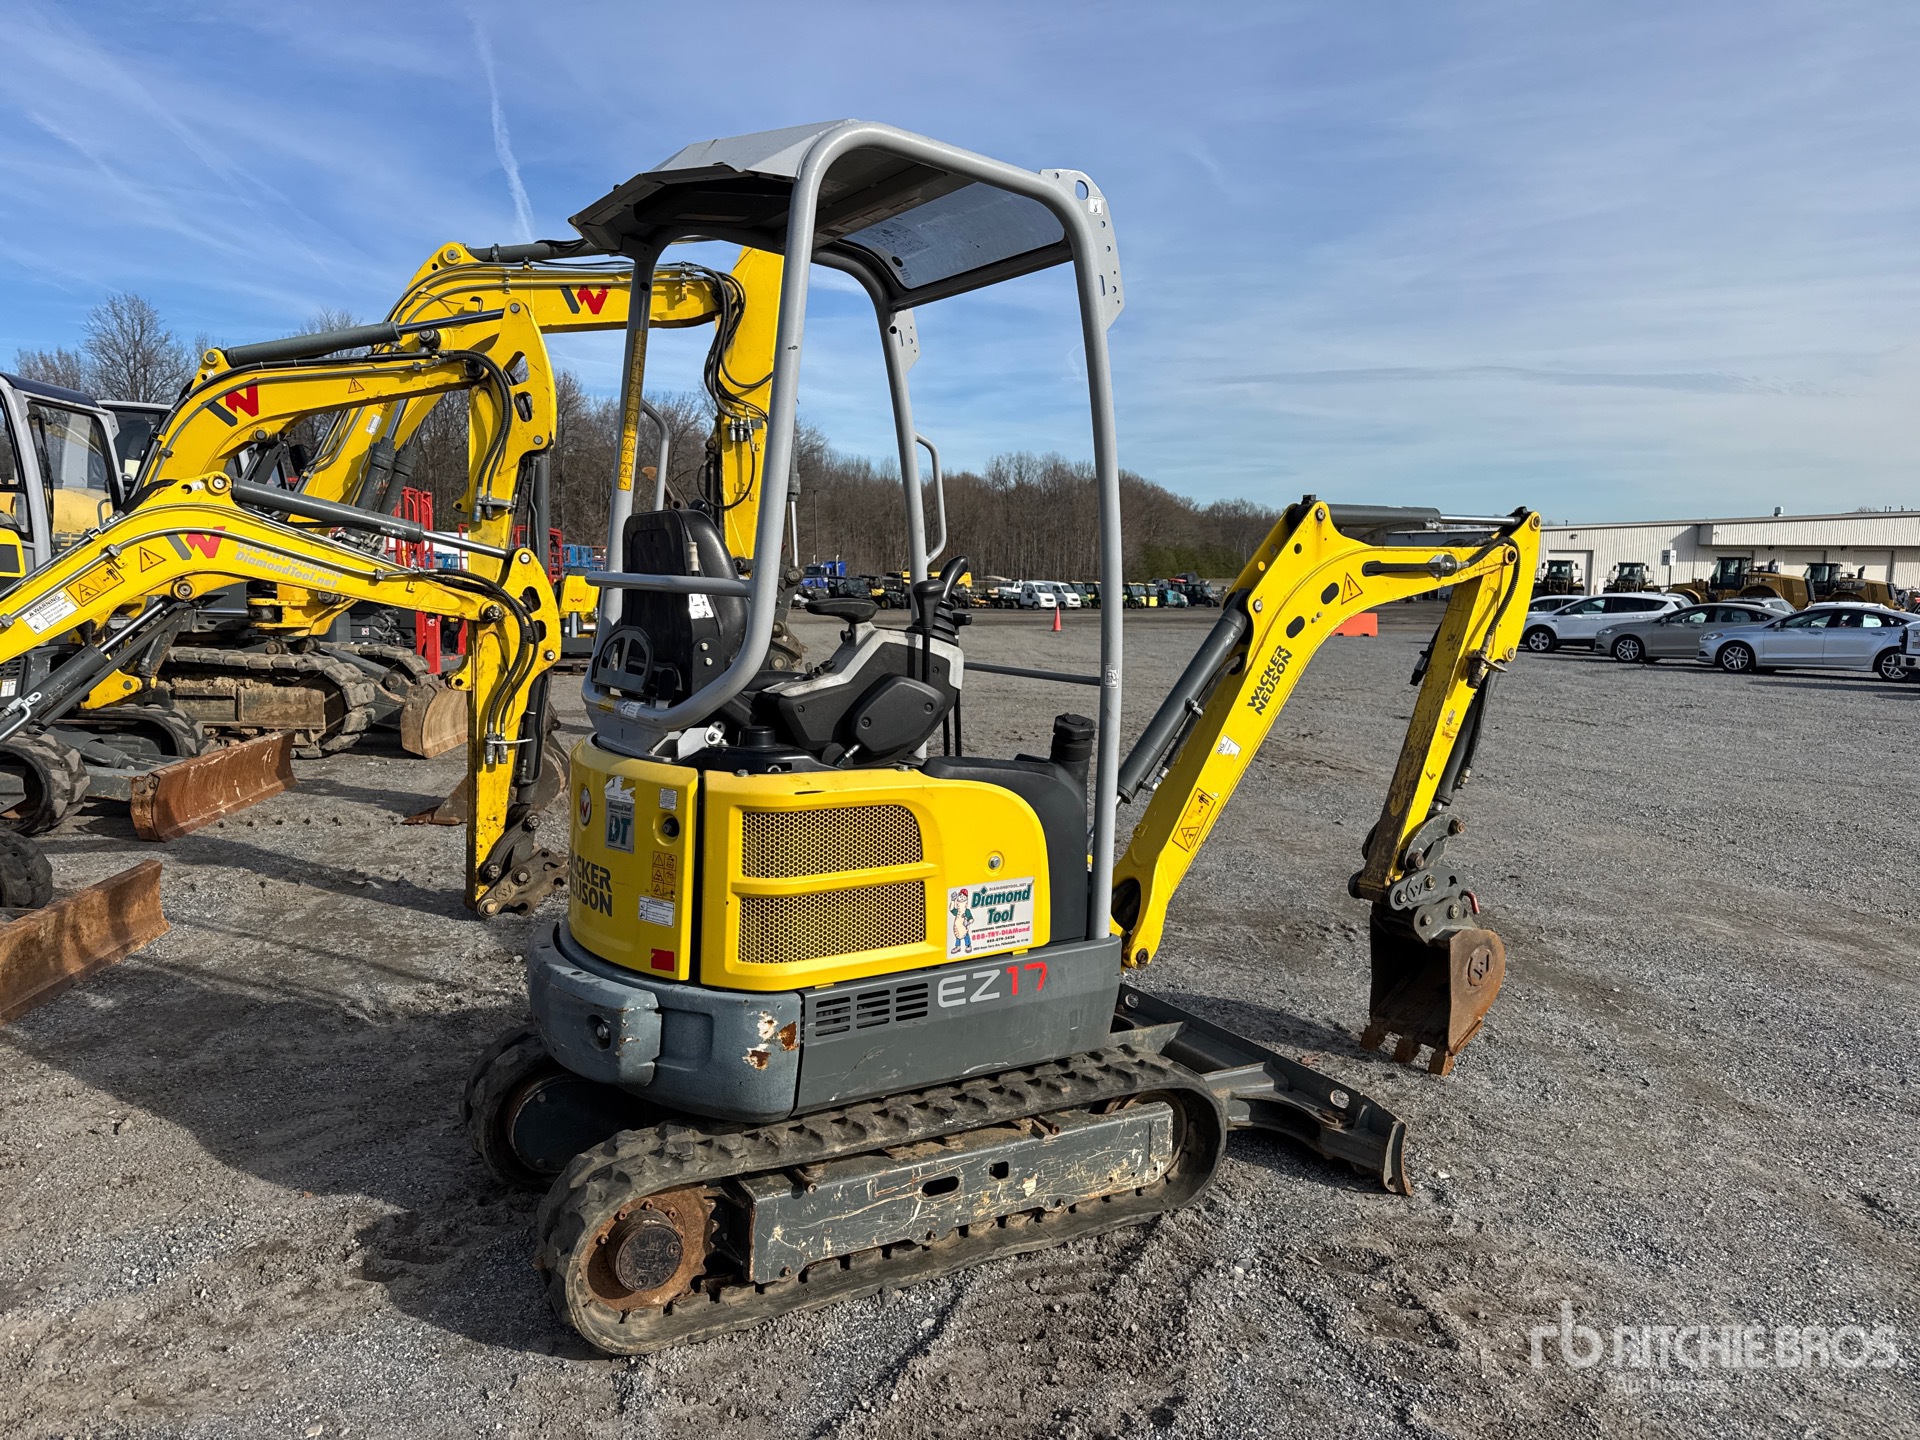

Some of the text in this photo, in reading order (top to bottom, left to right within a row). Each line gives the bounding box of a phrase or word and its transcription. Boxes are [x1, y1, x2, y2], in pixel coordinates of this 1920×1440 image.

[235, 551, 337, 588] DiamondTool.net
[33, 594, 61, 613] WARNING
[1247, 645, 1285, 708] WACKER
[1254, 649, 1293, 716] NEUSON
[971, 884, 1032, 908] Diamond
[988, 904, 1015, 924] Tool
[938, 962, 1048, 1008] EZ17
